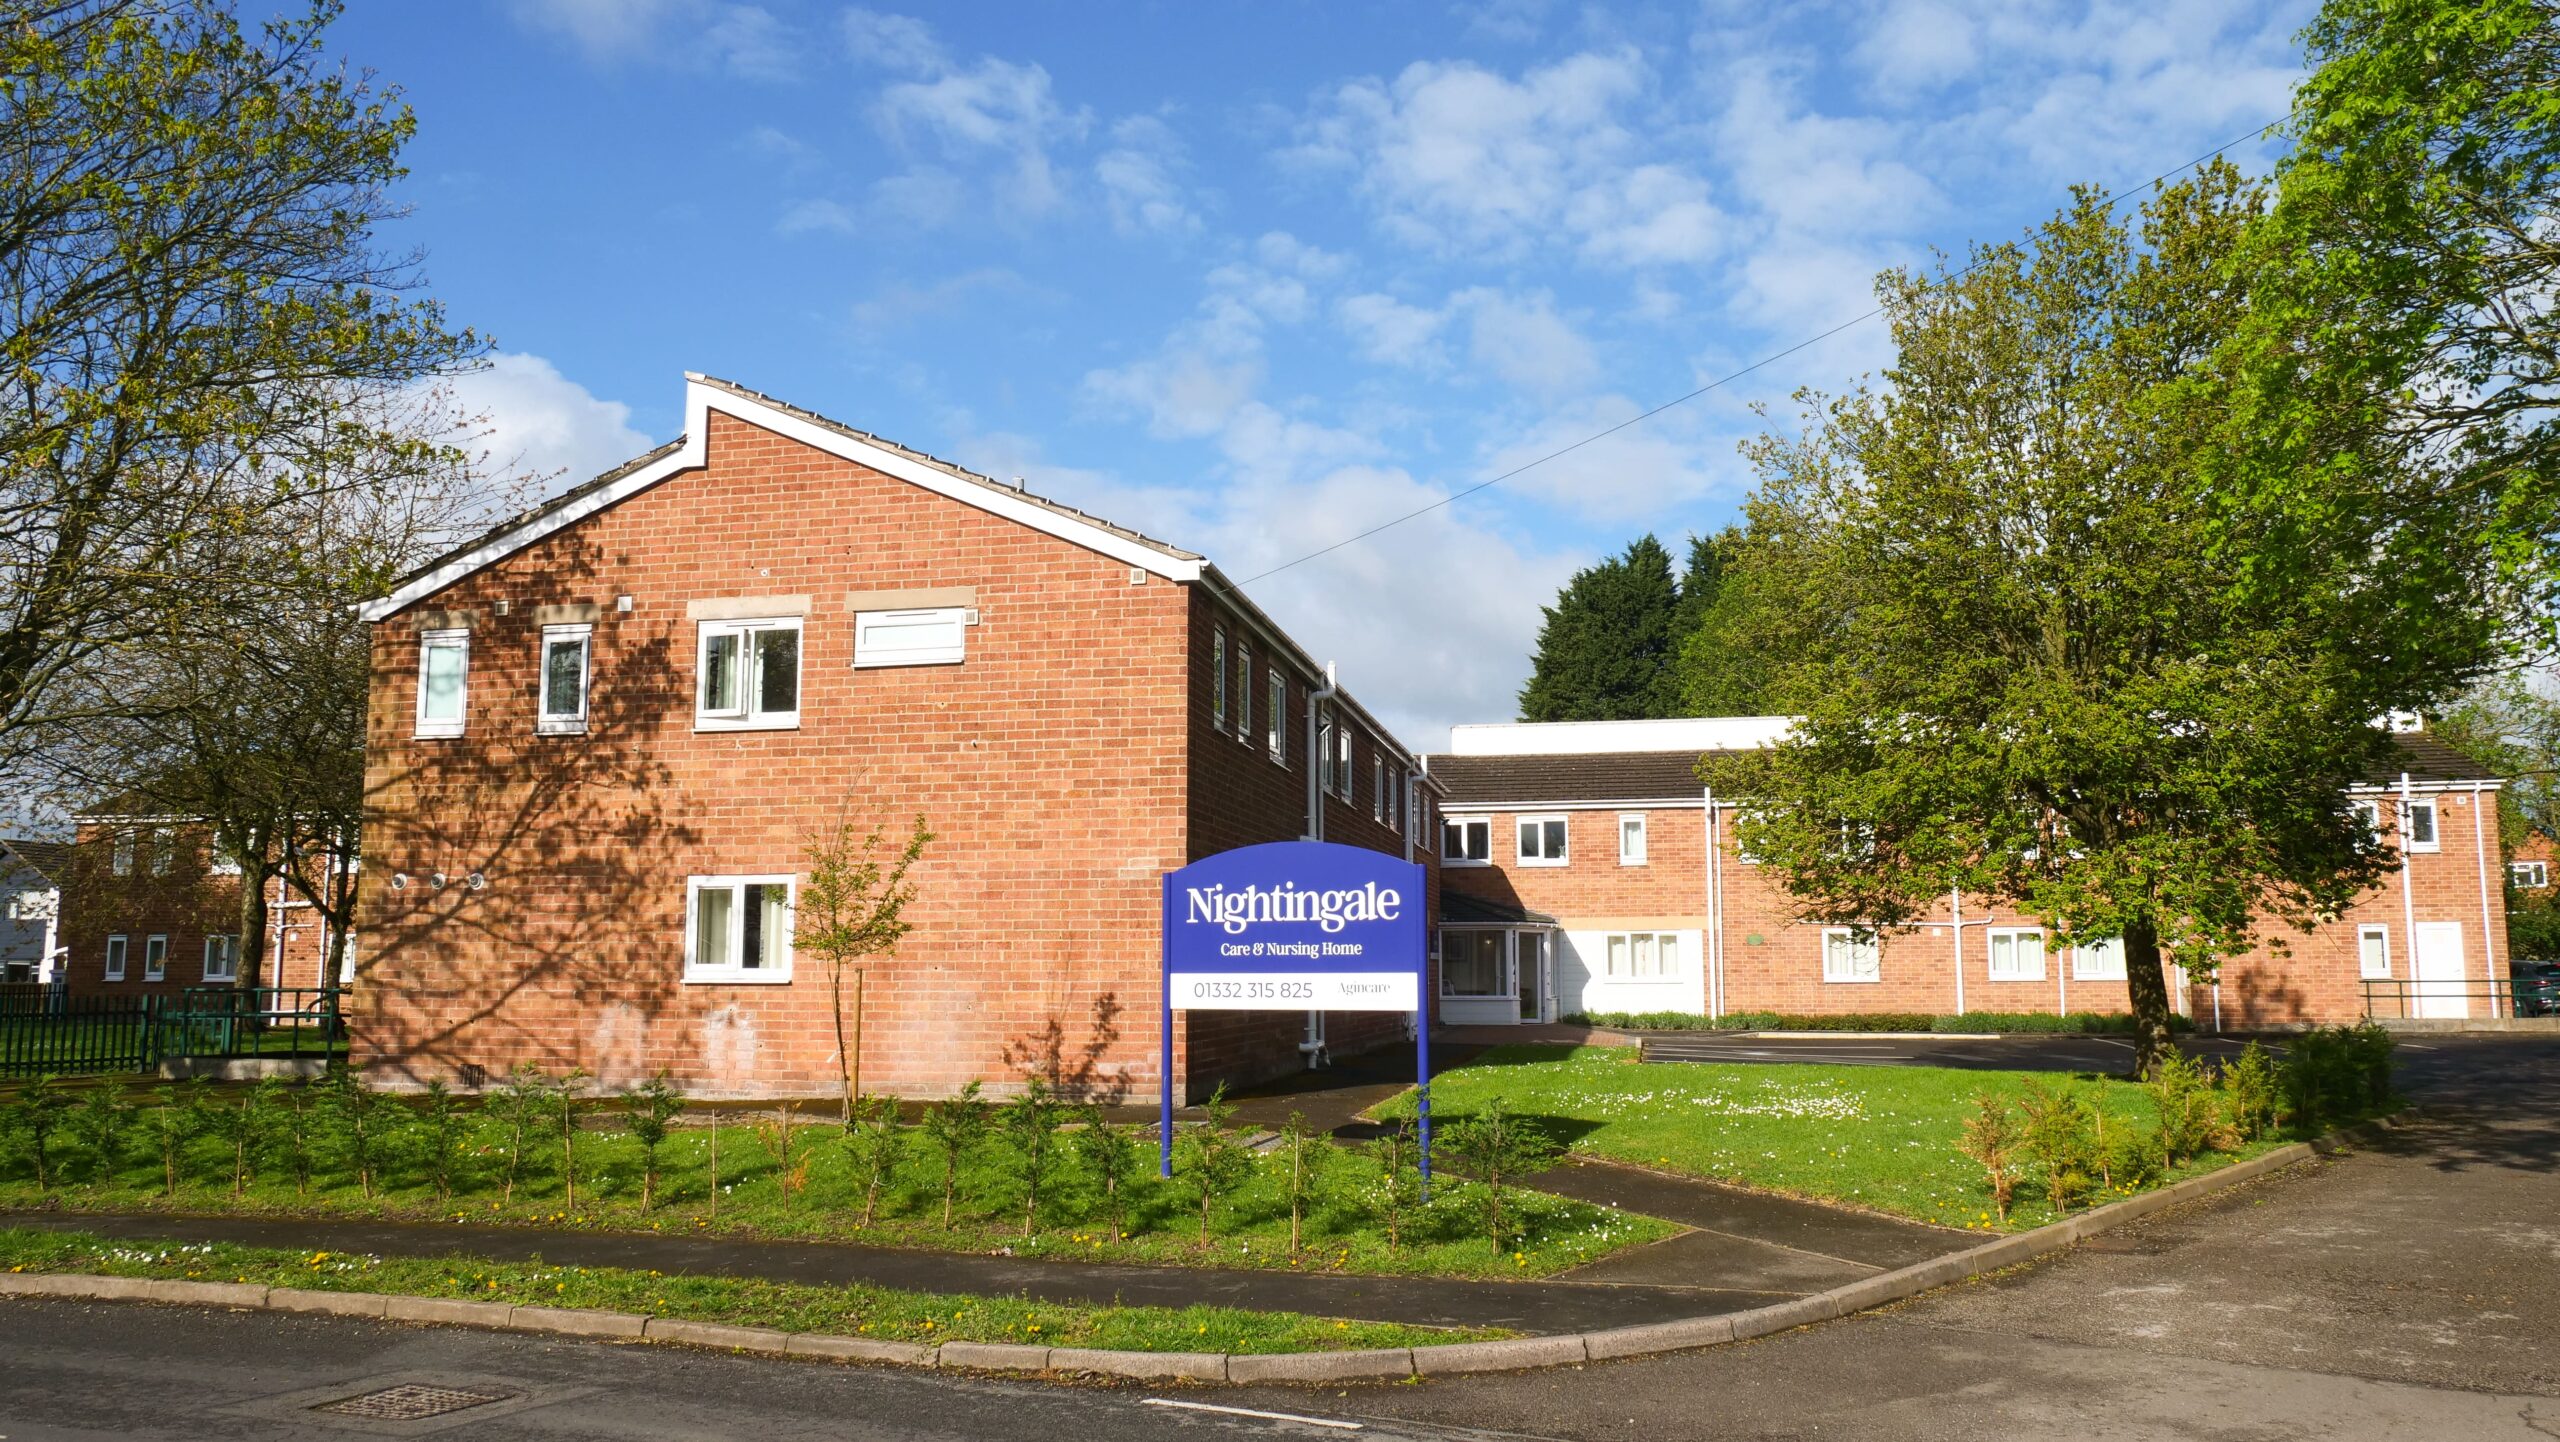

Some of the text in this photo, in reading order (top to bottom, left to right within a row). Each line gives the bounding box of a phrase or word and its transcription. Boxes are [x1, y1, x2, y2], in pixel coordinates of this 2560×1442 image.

[1186, 881, 1401, 935] Nightingale
[1220, 941, 1363, 959] Care & Nursing Home
[1194, 982, 1313, 998] 01332 315 825
[1337, 981, 1391, 995] Agincare
